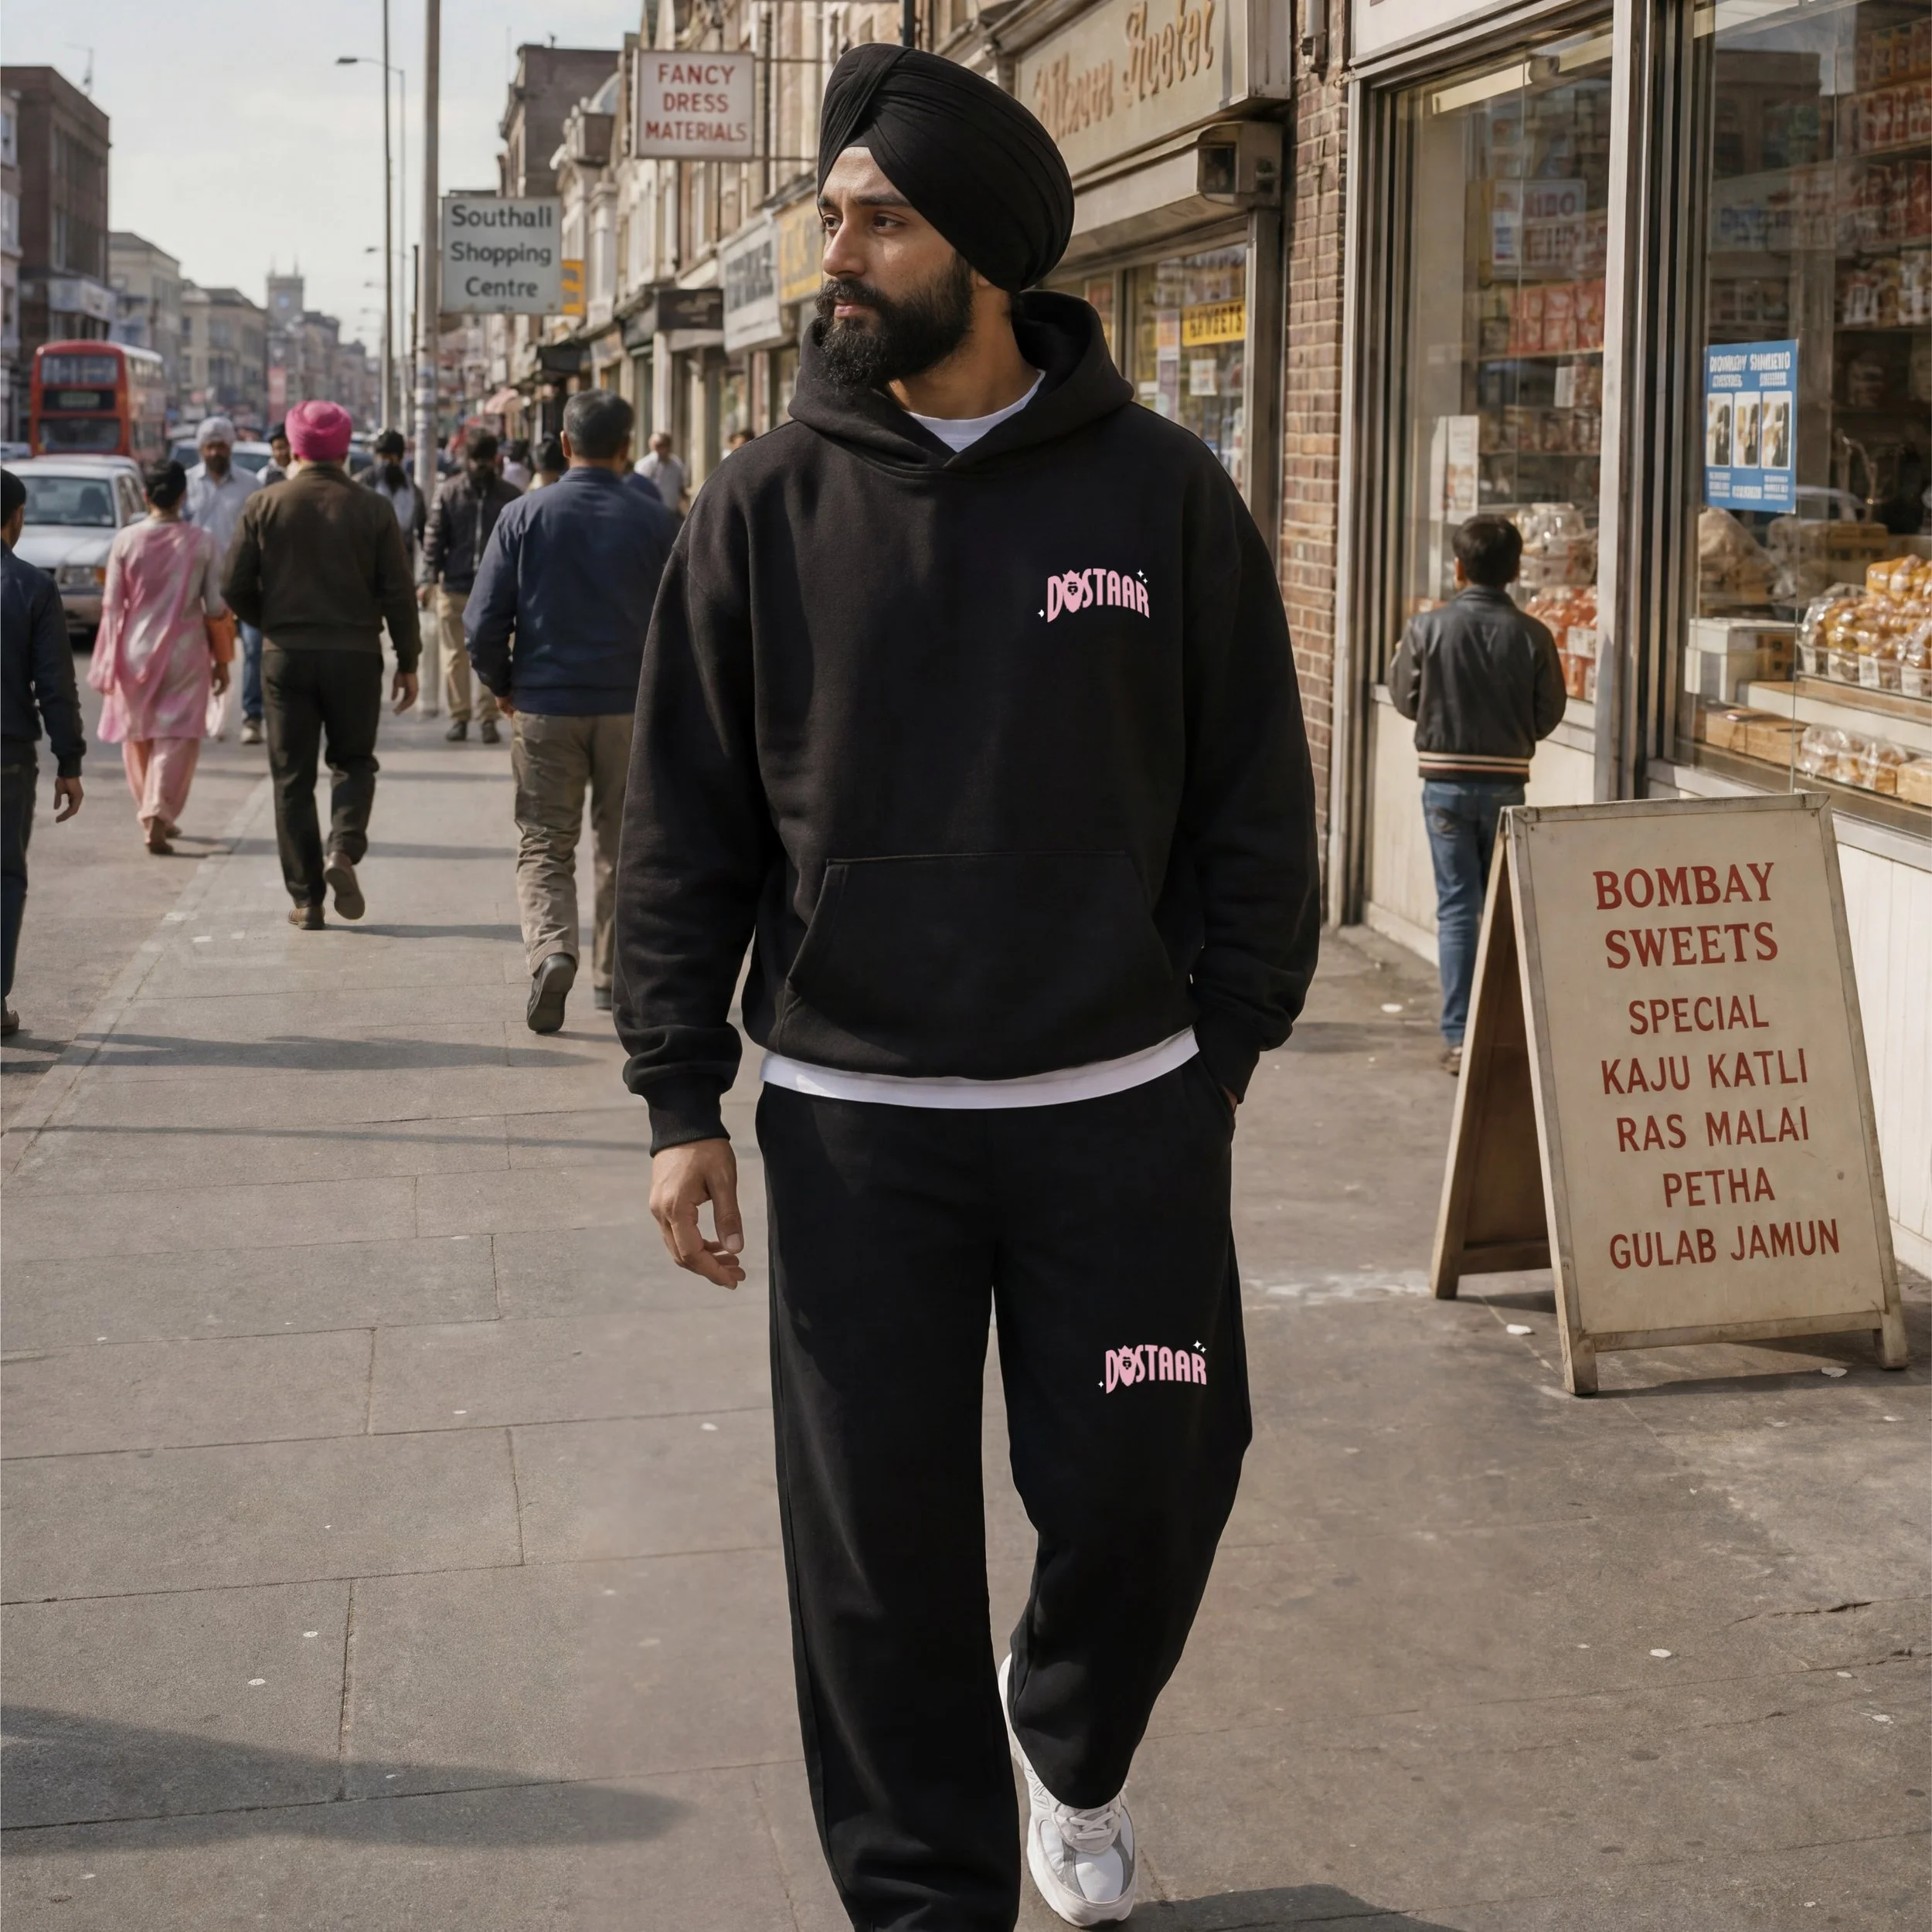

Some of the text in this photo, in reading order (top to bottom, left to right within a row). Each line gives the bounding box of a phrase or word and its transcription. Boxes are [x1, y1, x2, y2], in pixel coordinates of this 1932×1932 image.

[658, 63, 736, 85] FANCY
[663, 92, 729, 113] DRESS
[645, 120, 747, 141] MATERIALS
[451, 204, 552, 228] Southall
[451, 240, 552, 267] Shopping
[464, 276, 539, 298] Centre
[1593, 862, 1774, 910] BOMBAY
[1605, 922, 1778, 970] SWEETS
[1628, 995, 1769, 1035] SPECIAL
[1600, 1048, 1808, 1095] KAJU KATLI
[1616, 1106, 1809, 1152] RAS MALAI
[1662, 1167, 1776, 1208] PETHA
[1609, 1219, 1840, 1270] GULAB JAMUN
